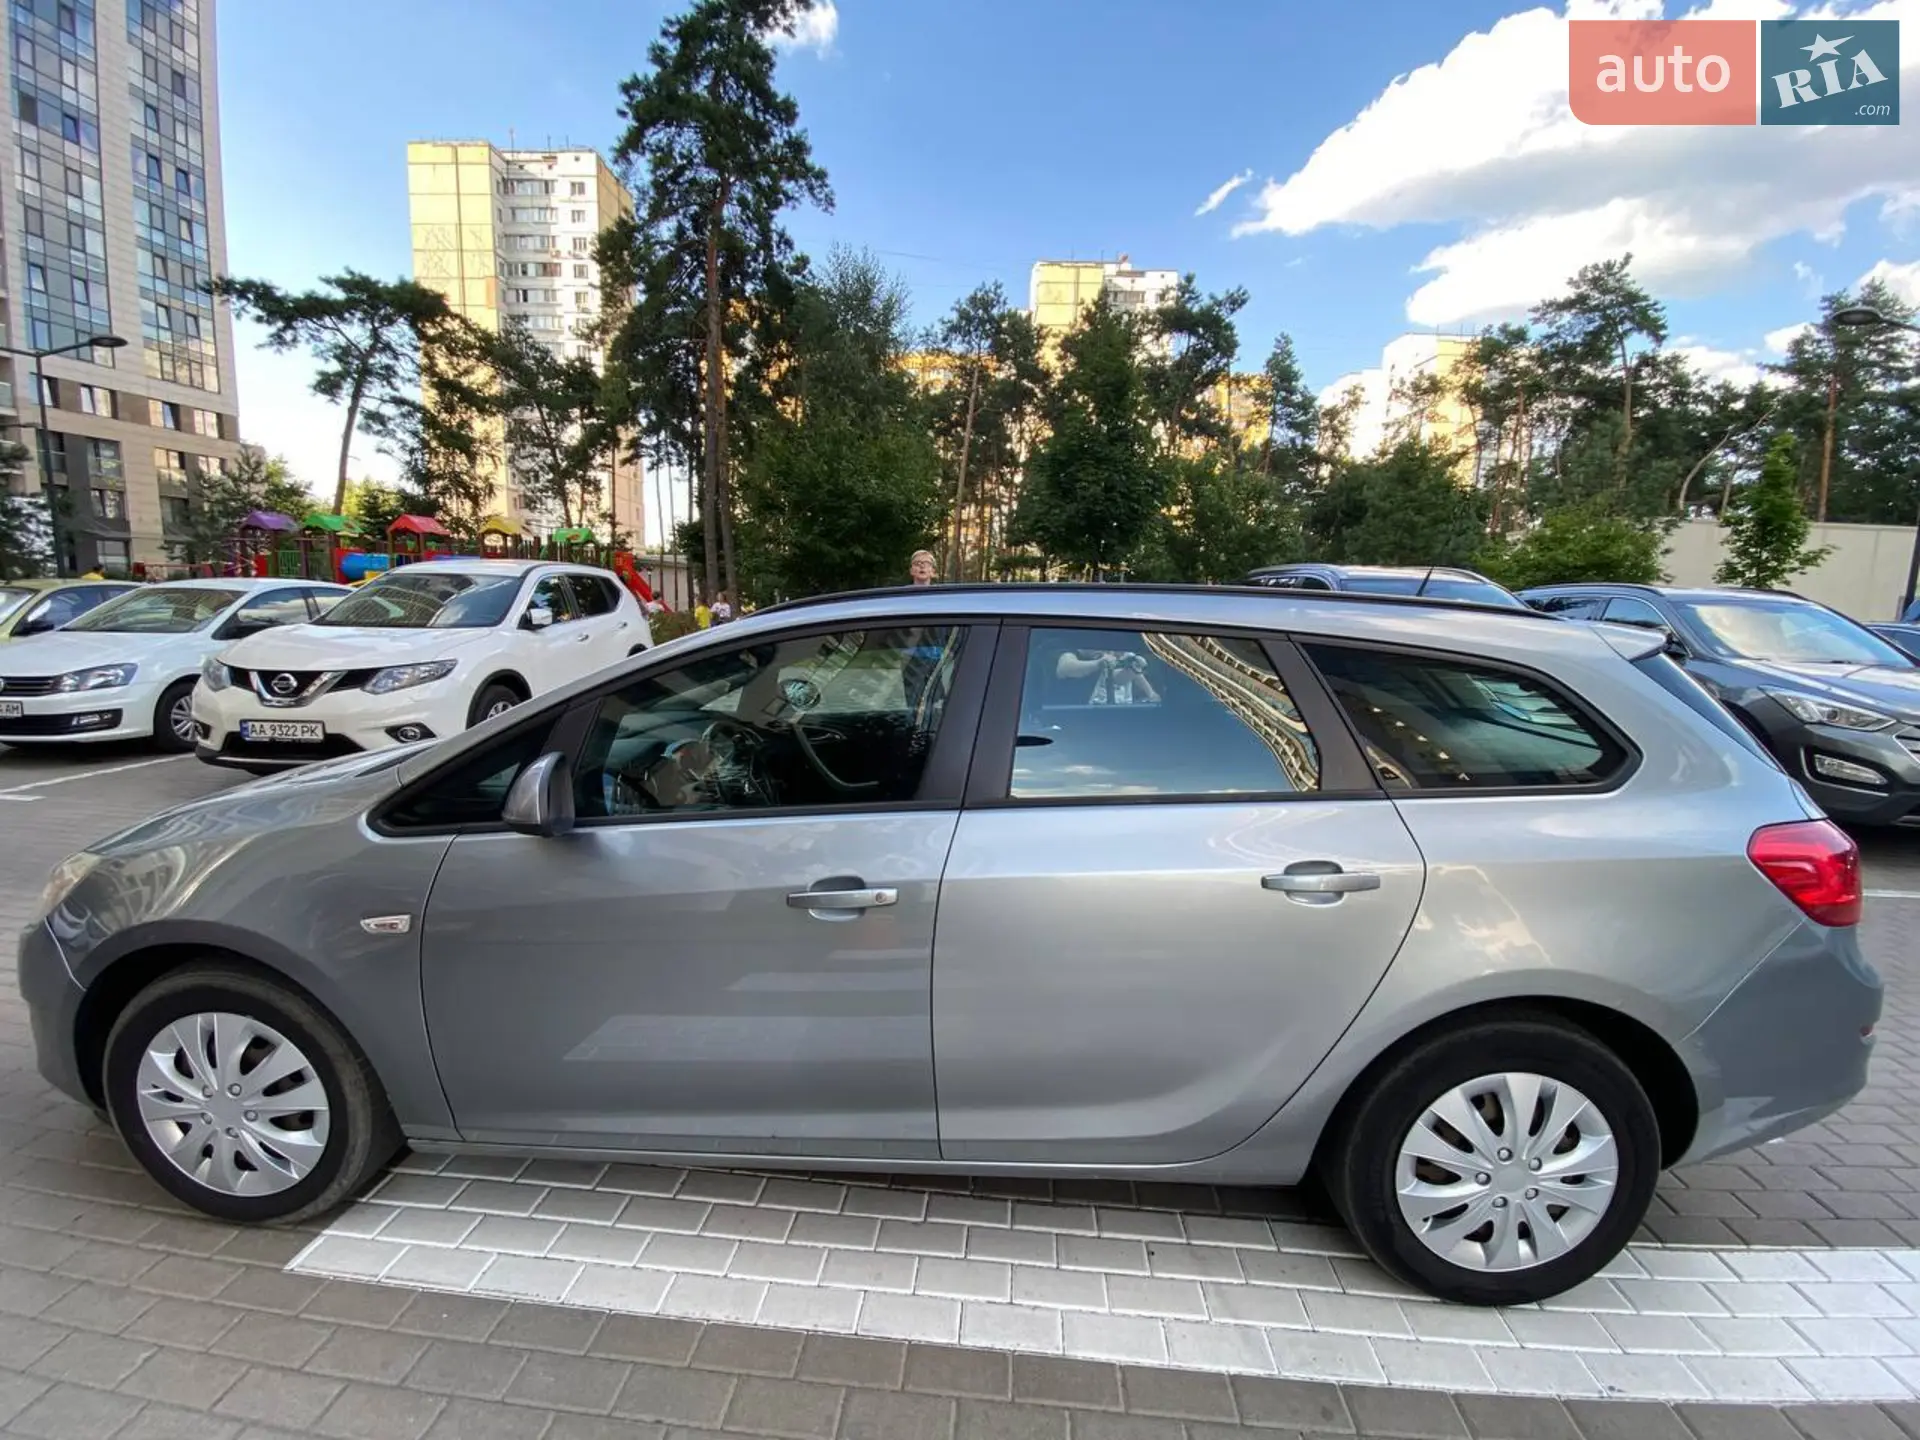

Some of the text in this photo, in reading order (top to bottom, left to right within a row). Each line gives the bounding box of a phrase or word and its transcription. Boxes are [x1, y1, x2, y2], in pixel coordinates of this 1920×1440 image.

[250, 723, 319, 737] AA 9322 PK
